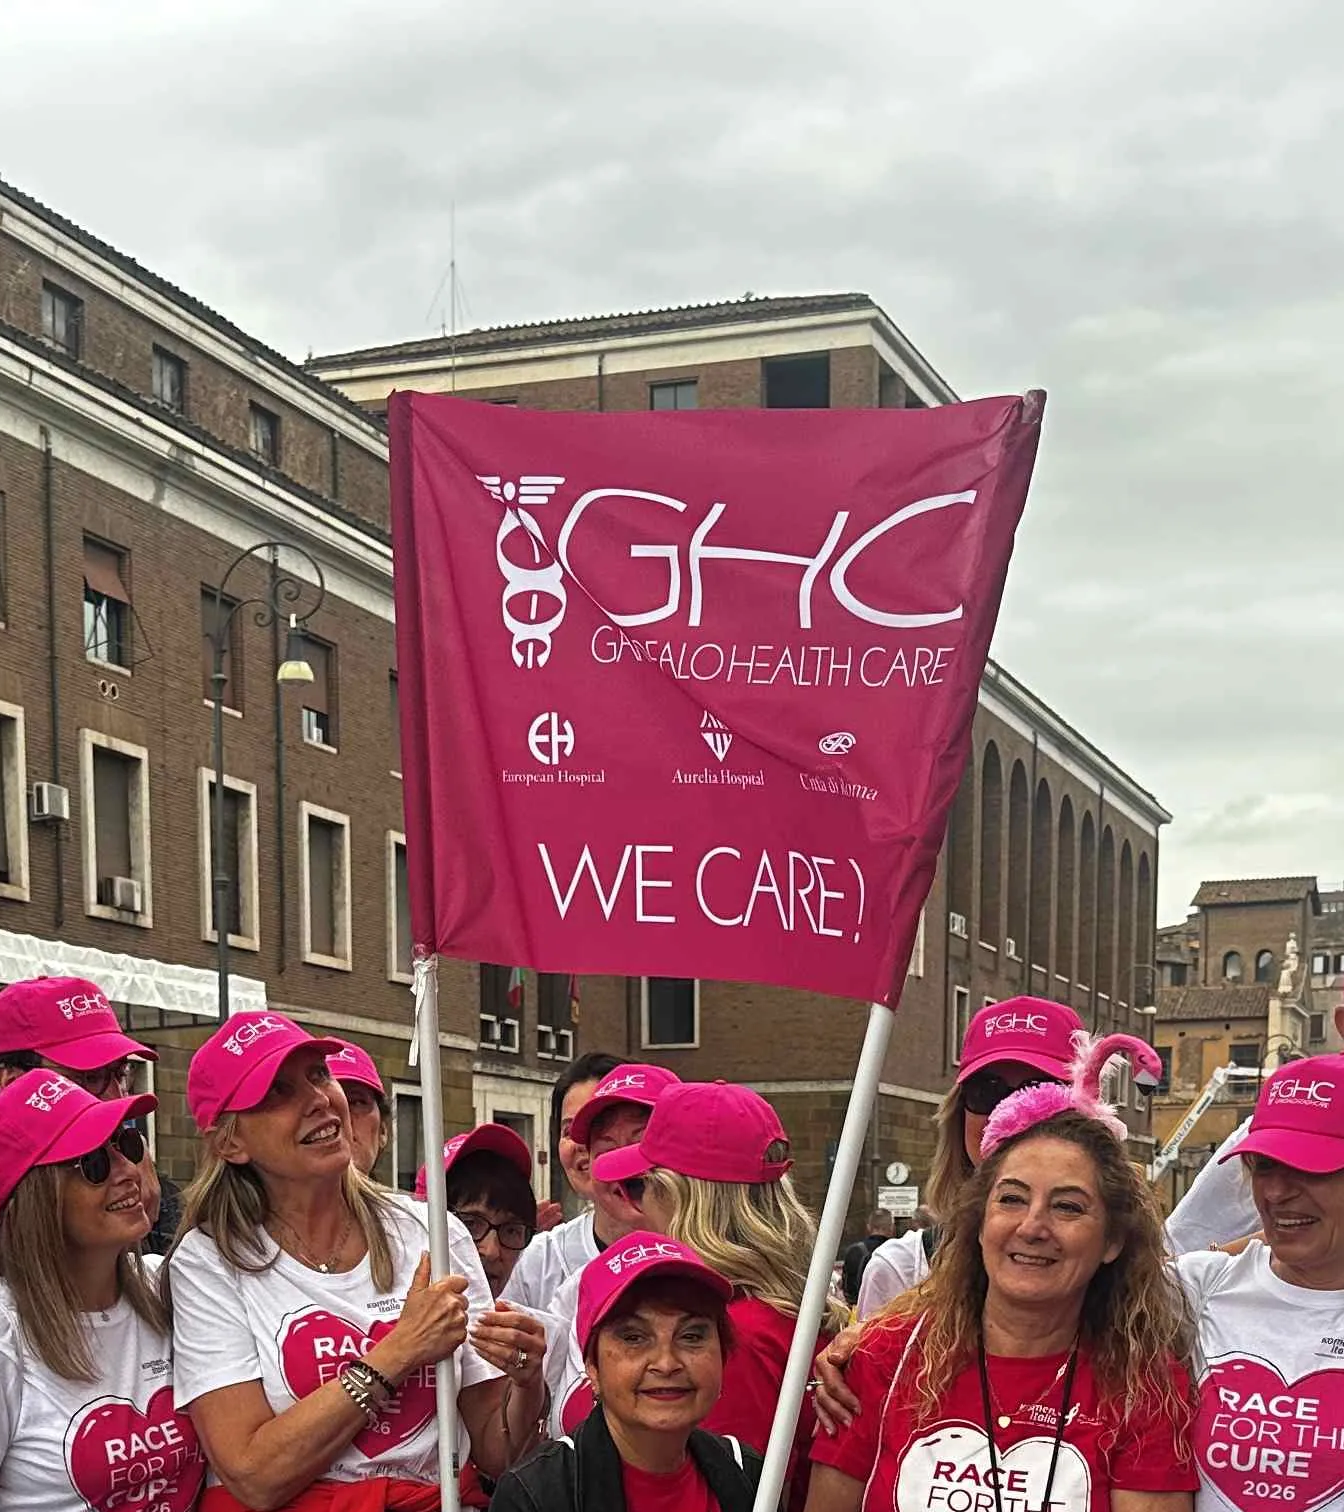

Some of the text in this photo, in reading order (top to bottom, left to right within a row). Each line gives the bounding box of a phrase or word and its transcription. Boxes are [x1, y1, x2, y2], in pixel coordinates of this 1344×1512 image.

[557, 487, 977, 629] GHC
[726, 645, 852, 686] HEALTH
[860, 646, 956, 687] CARE
[502, 769, 605, 785] European Hospital
[672, 769, 765, 787] Aurelia Hospital
[538, 843, 676, 925] WE
[235, 1016, 284, 1043] GHC
[996, 1012, 1049, 1034] GHC
[1277, 1079, 1337, 1103] GHC
[621, 1241, 682, 1264] GHC
[314, 1336, 372, 1360] RAC
[408, 1368, 438, 1389] HE
[1216, 1385, 1320, 1422] RACE
[103, 1420, 184, 1465] RACE
[1210, 1412, 1285, 1446] FOR
[109, 1456, 164, 1490] FOR
[1206, 1442, 1314, 1479] CURE
[933, 1460, 1029, 1494] RACE
[1242, 1480, 1297, 1502] 2026
